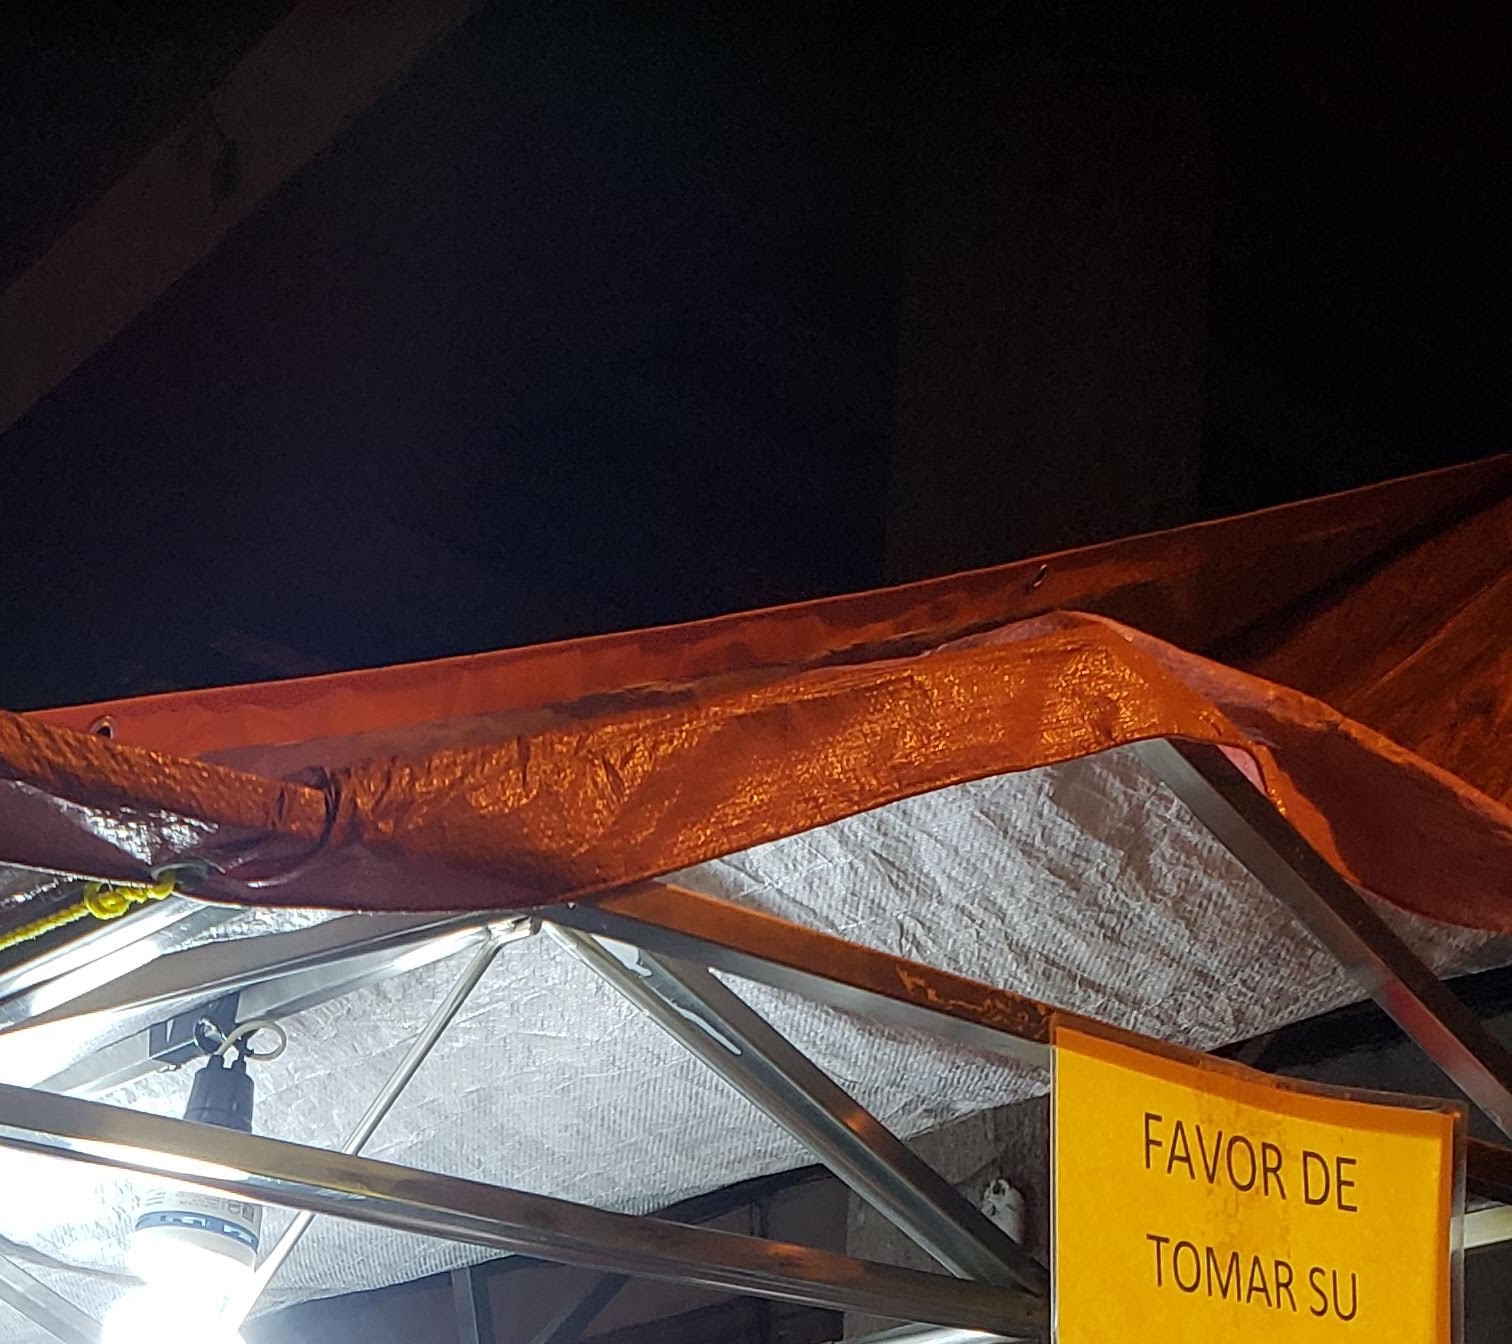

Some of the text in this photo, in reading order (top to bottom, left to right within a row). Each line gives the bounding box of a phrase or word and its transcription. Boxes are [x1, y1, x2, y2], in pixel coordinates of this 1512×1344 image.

[1144, 1112, 1358, 1212] FAVOR DE
[1146, 1233, 1358, 1321] TOMAR SU
